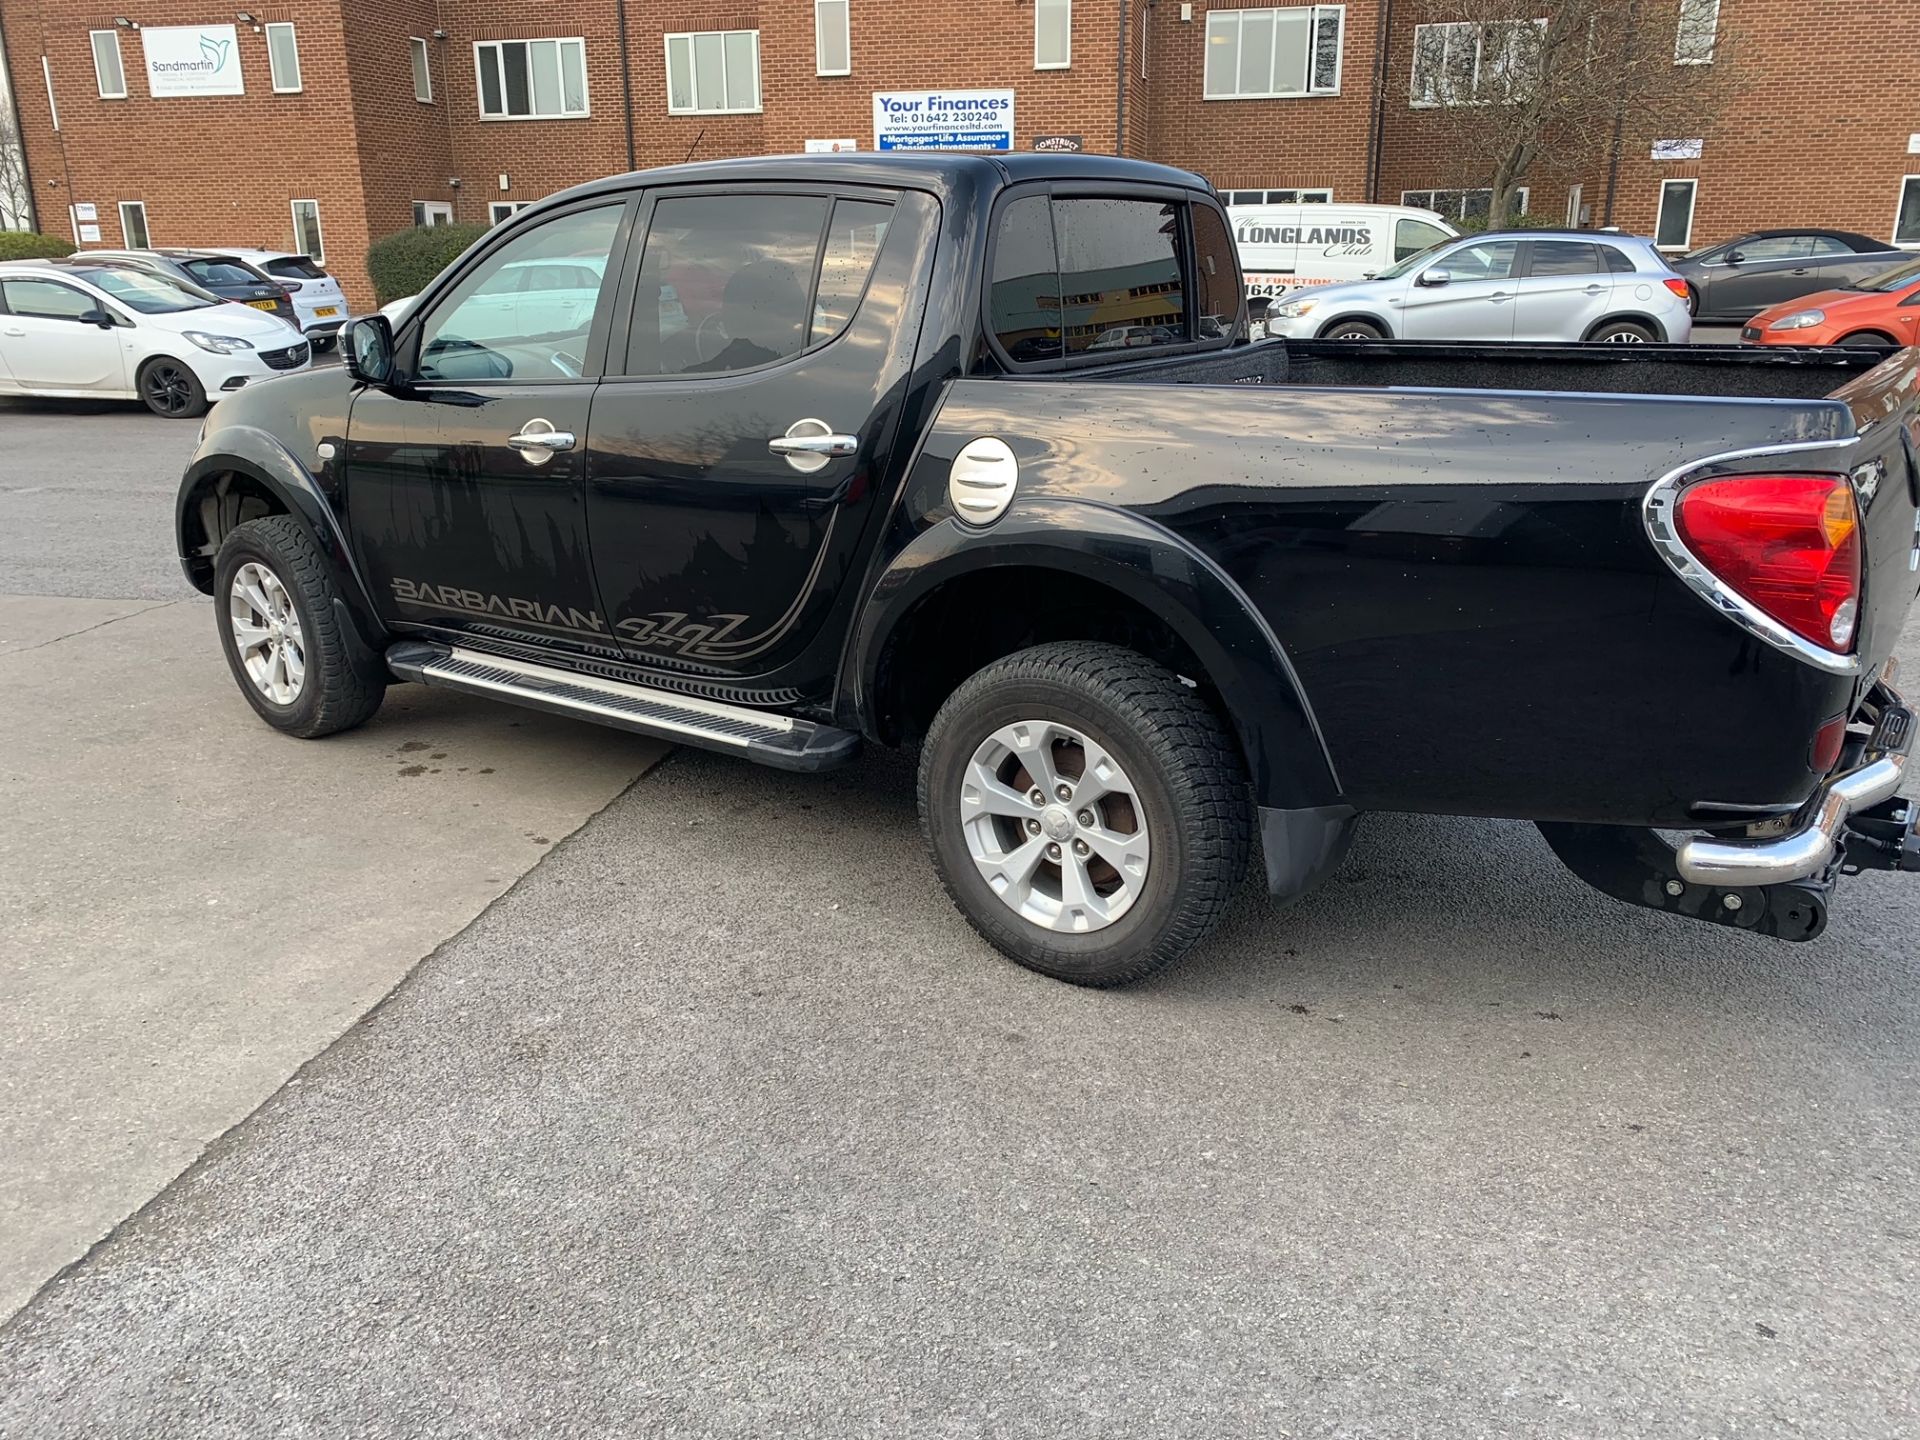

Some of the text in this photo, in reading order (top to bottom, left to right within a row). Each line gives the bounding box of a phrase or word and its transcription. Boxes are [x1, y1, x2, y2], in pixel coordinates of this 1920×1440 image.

[152, 60, 214, 72] Sandmartin
[879, 95, 1009, 112] Your Finances
[889, 111, 998, 124] Tel: 01642 230240
[885, 122, 1003, 133] www.yourfinancesltd.com
[1035, 137, 1079, 151] CONSTRUCT
[1235, 217, 1259, 228] The
[1237, 228, 1371, 244] LONGLANDS
[1323, 241, 1374, 258] Club
[1265, 277, 1331, 286] FUNCTION
[1245, 284, 1287, 296] 1642
[390, 577, 604, 631] BARBARIAN
